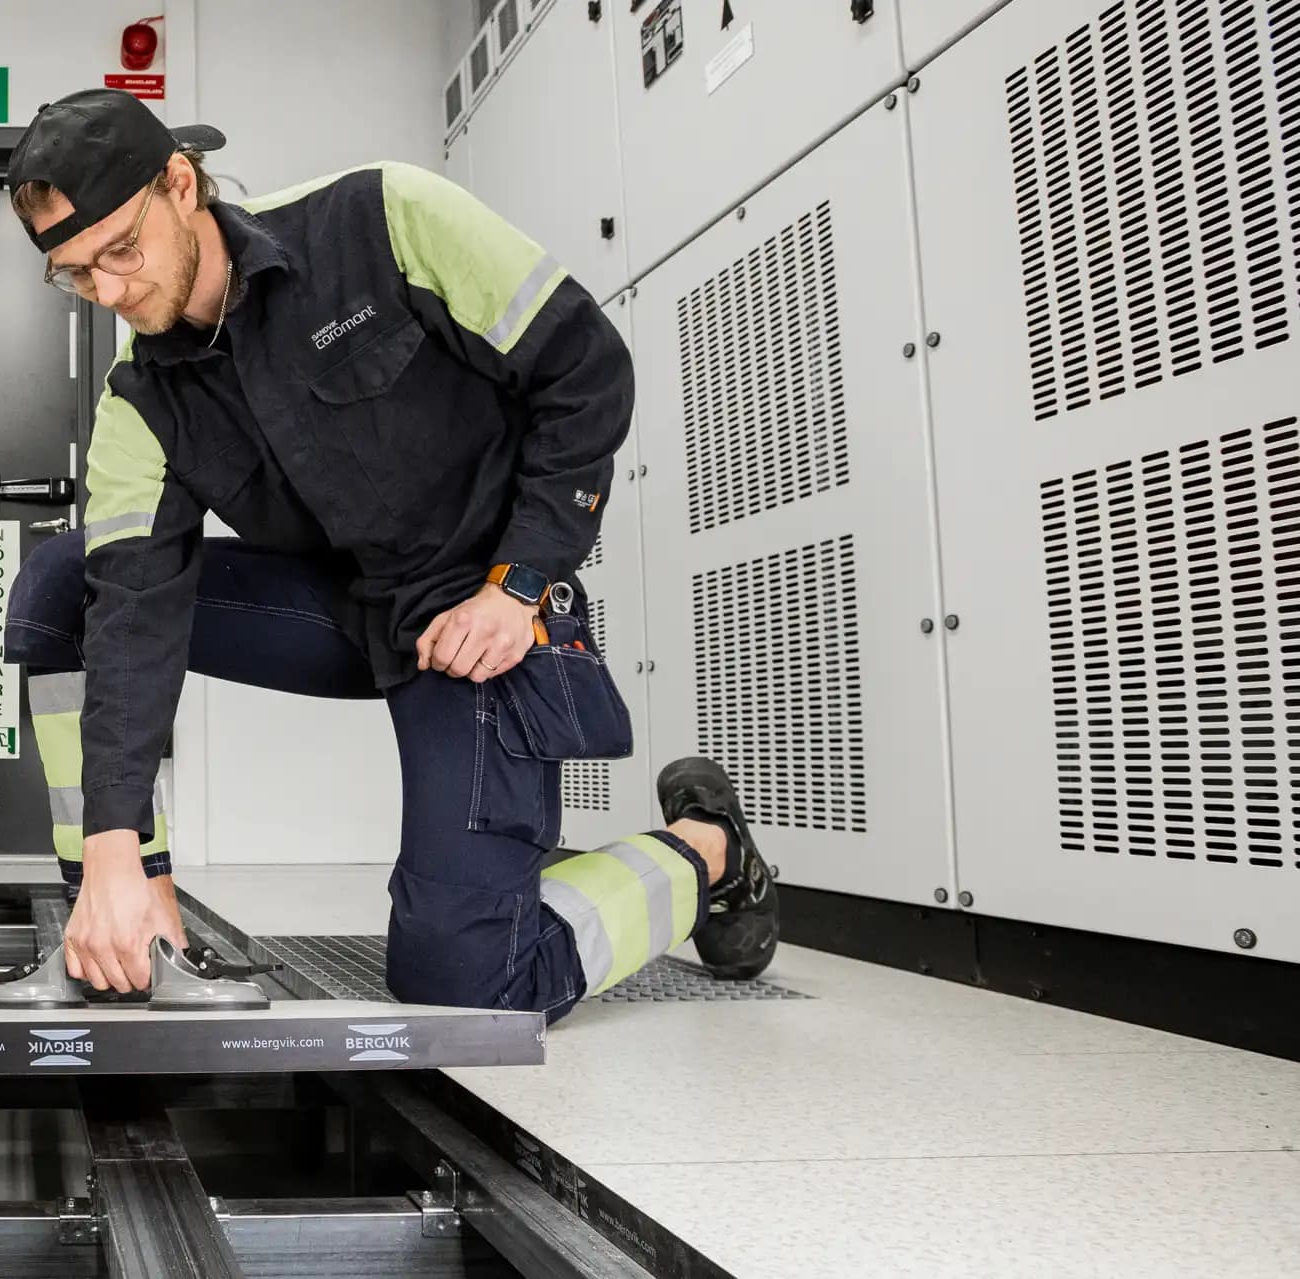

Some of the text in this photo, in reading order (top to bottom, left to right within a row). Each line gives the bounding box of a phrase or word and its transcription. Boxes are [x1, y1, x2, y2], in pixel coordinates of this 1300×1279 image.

[315, 305, 377, 349] coromant
[28, 1041, 94, 1053] BERGVIK
[221, 1036, 411, 1051] www.bergvik.com BERGVIK
